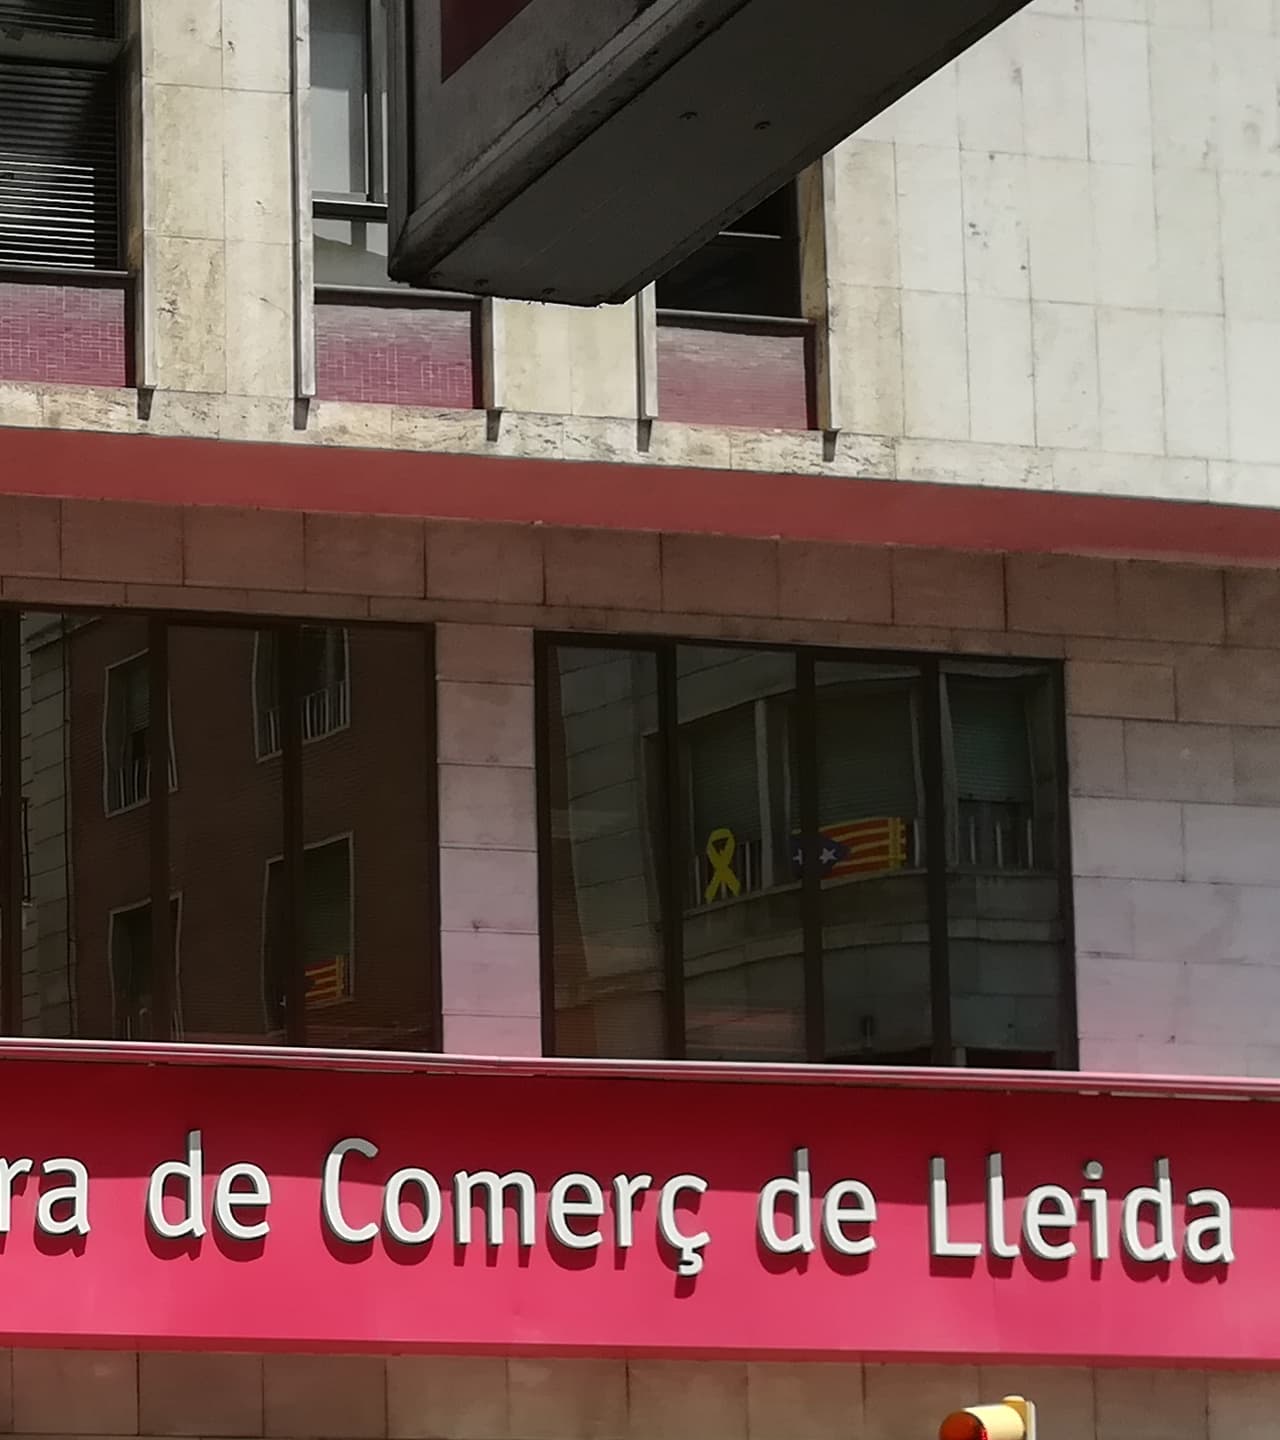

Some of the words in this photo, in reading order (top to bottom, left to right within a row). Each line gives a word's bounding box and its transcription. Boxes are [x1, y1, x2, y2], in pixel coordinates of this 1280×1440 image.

[143, 1130, 272, 1240] de
[320, 1137, 712, 1276] Comerç
[756, 1148, 878, 1256] de
[932, 1153, 1237, 1264] Lleida
